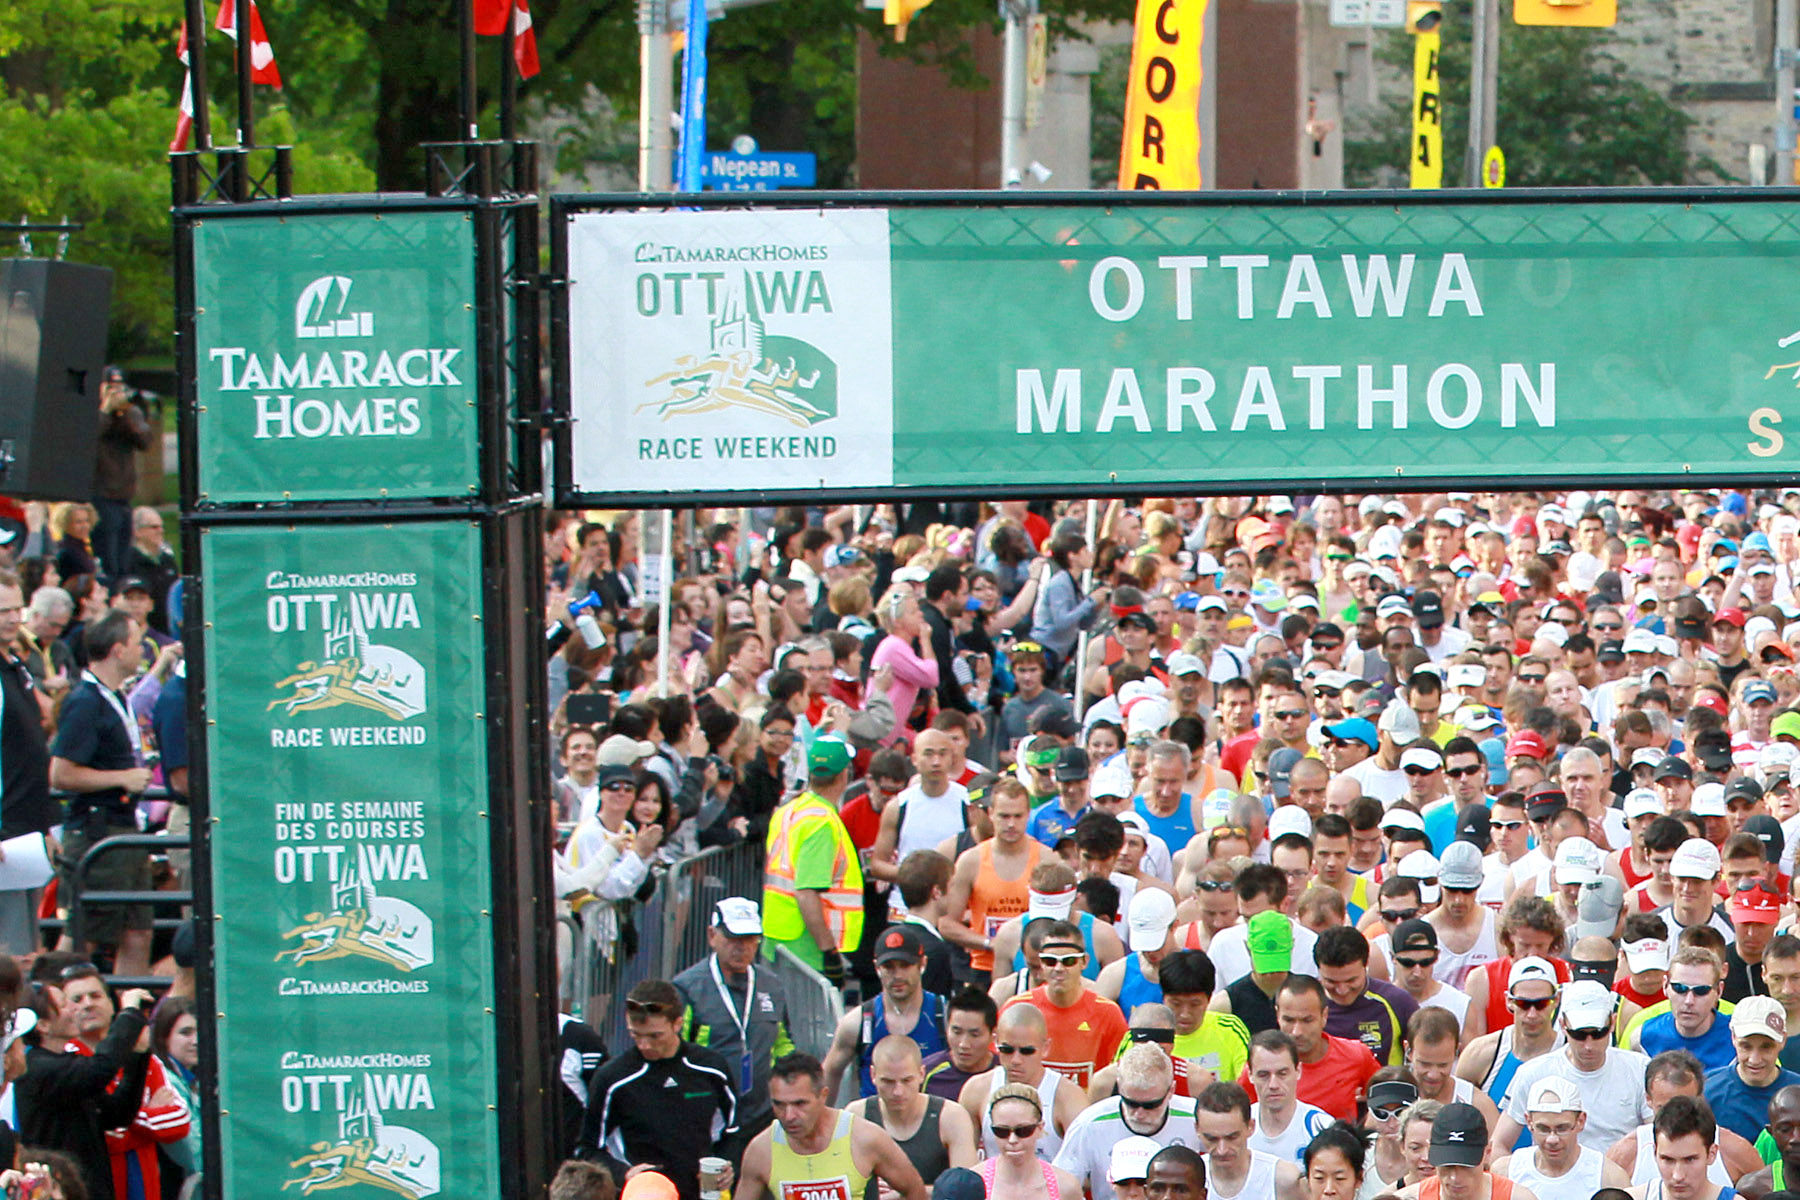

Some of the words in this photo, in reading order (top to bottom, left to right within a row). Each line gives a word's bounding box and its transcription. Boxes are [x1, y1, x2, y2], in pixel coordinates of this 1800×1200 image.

[712, 156, 780, 181] Nepean
[1089, 254, 1483, 322] OTTAWA
[209, 347, 462, 393] TAMARACK
[1016, 363, 1555, 433] MARATHON
[253, 396, 421, 439] HOMES
[639, 438, 702, 460] RACE
[715, 436, 836, 458] WEEKEND
[271, 728, 322, 748] RACE
[330, 726, 426, 747] WEEKEND
[275, 803, 305, 820] FIN
[312, 803, 334, 820] DE
[342, 801, 424, 819] SEMAINE
[276, 822, 315, 841] DES
[326, 820, 425, 840] COURSES
